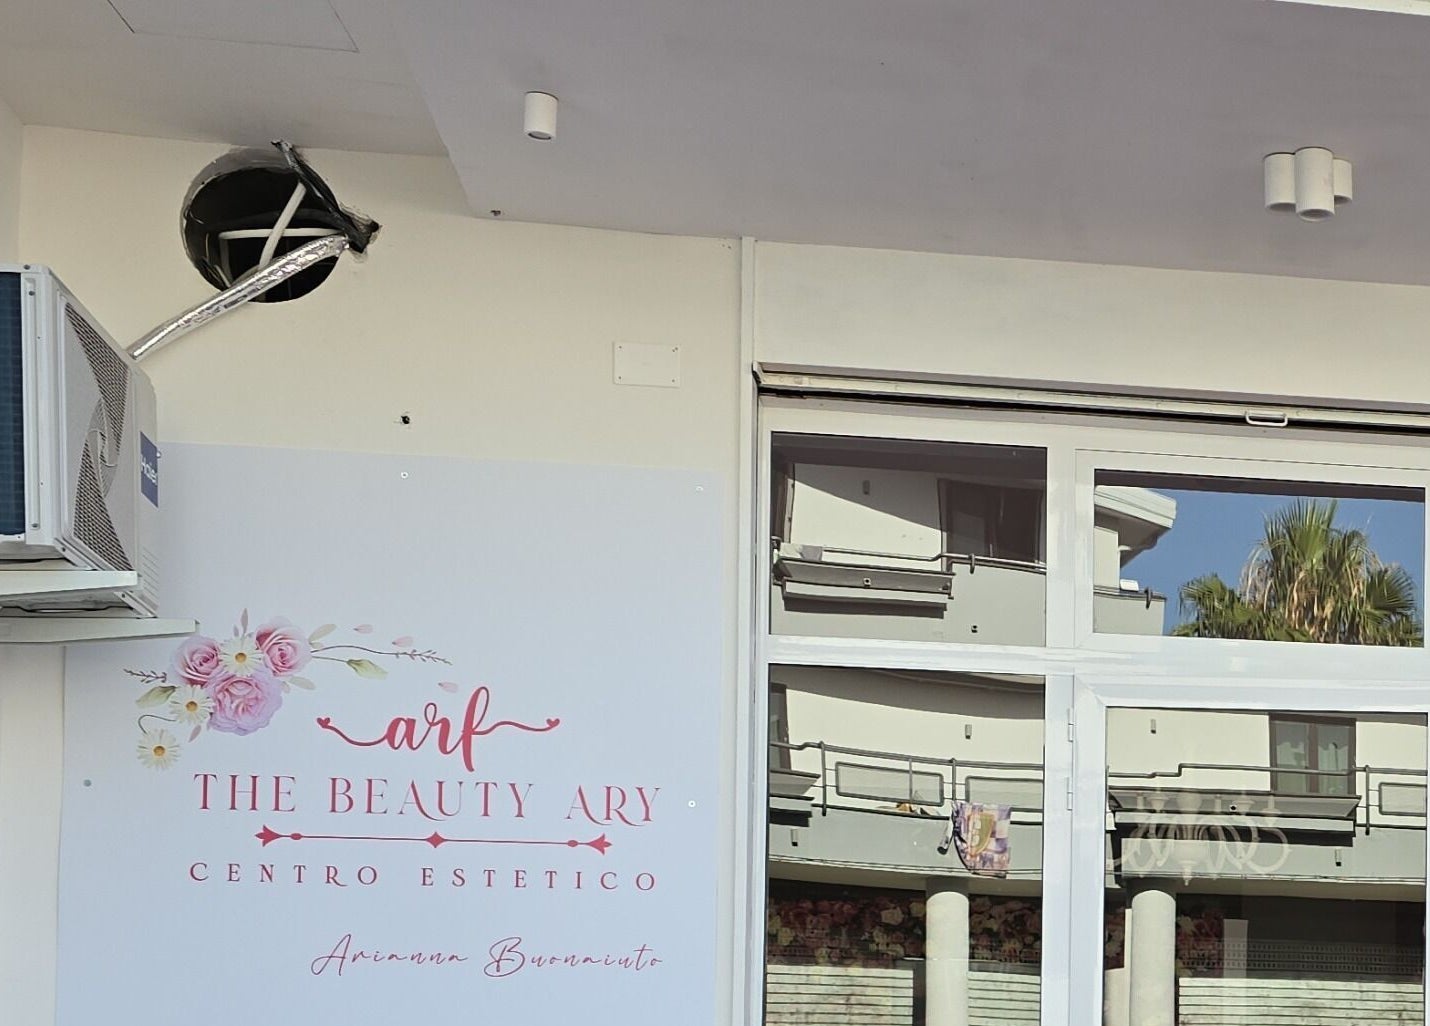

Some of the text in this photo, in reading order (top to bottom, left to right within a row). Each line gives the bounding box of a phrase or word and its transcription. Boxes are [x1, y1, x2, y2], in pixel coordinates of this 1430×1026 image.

[193, 773, 662, 827] THE BEAUTY ARY
[189, 862, 656, 890] CENTRO ESTETICO
[311, 933, 664, 978] Arianna Buonaiuto
